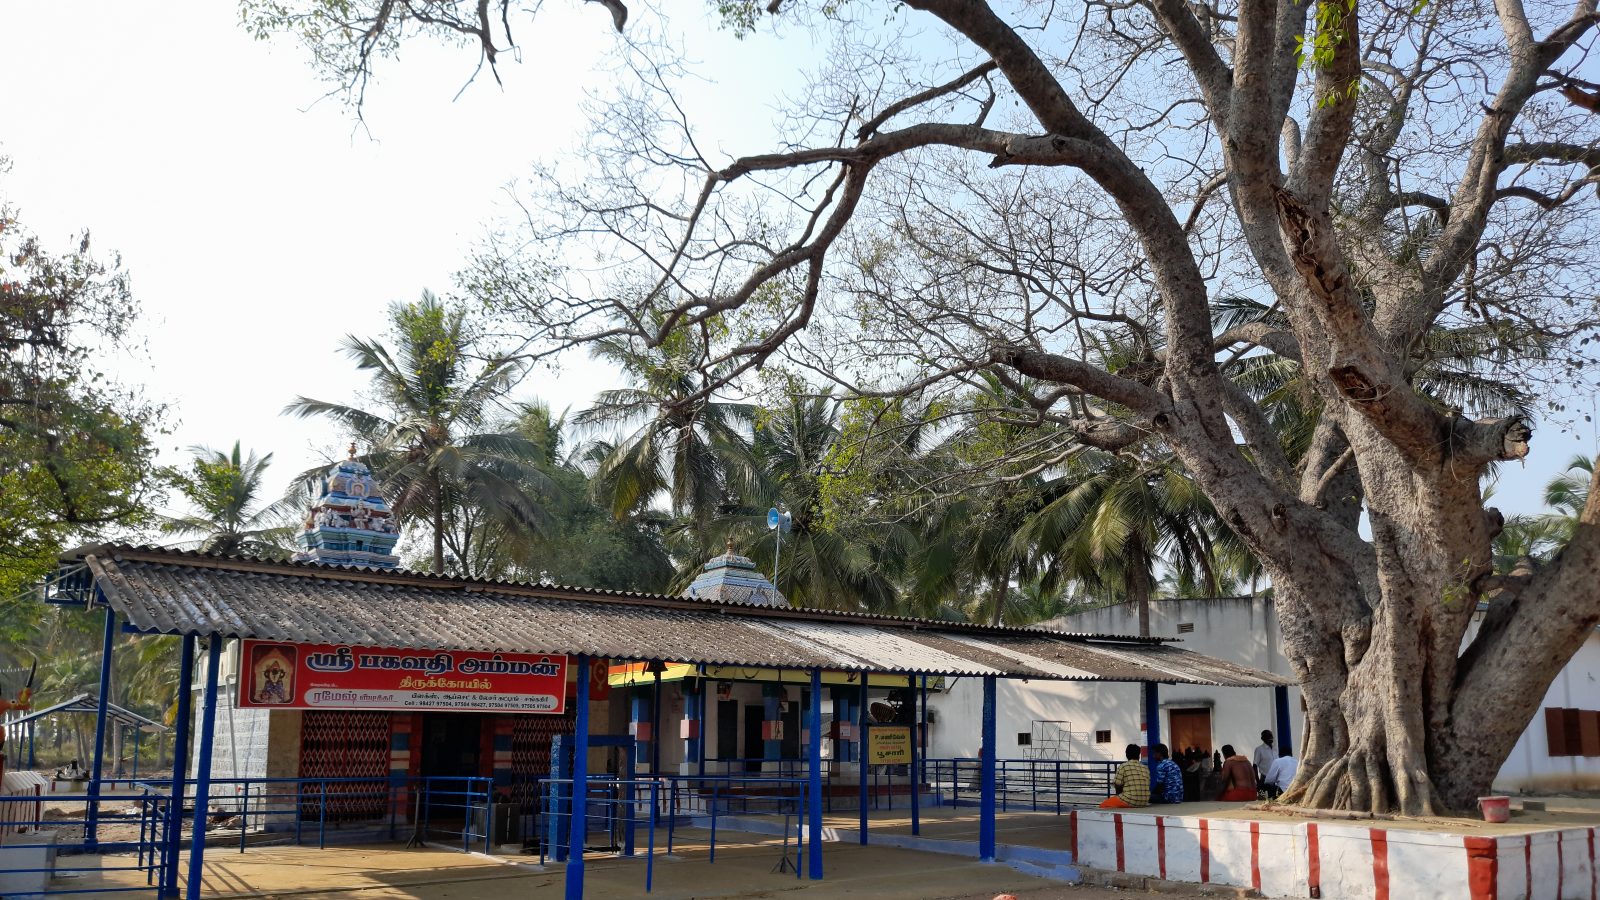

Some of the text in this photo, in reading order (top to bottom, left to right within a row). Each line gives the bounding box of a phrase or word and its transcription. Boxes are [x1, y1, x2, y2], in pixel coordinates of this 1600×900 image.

[306, 647, 560, 677] ஸ்ரீ பகவதி அம்மன்
[398, 676, 492, 690] திருக்கோயில்
[312, 690, 358, 704] ரமேஷ்
